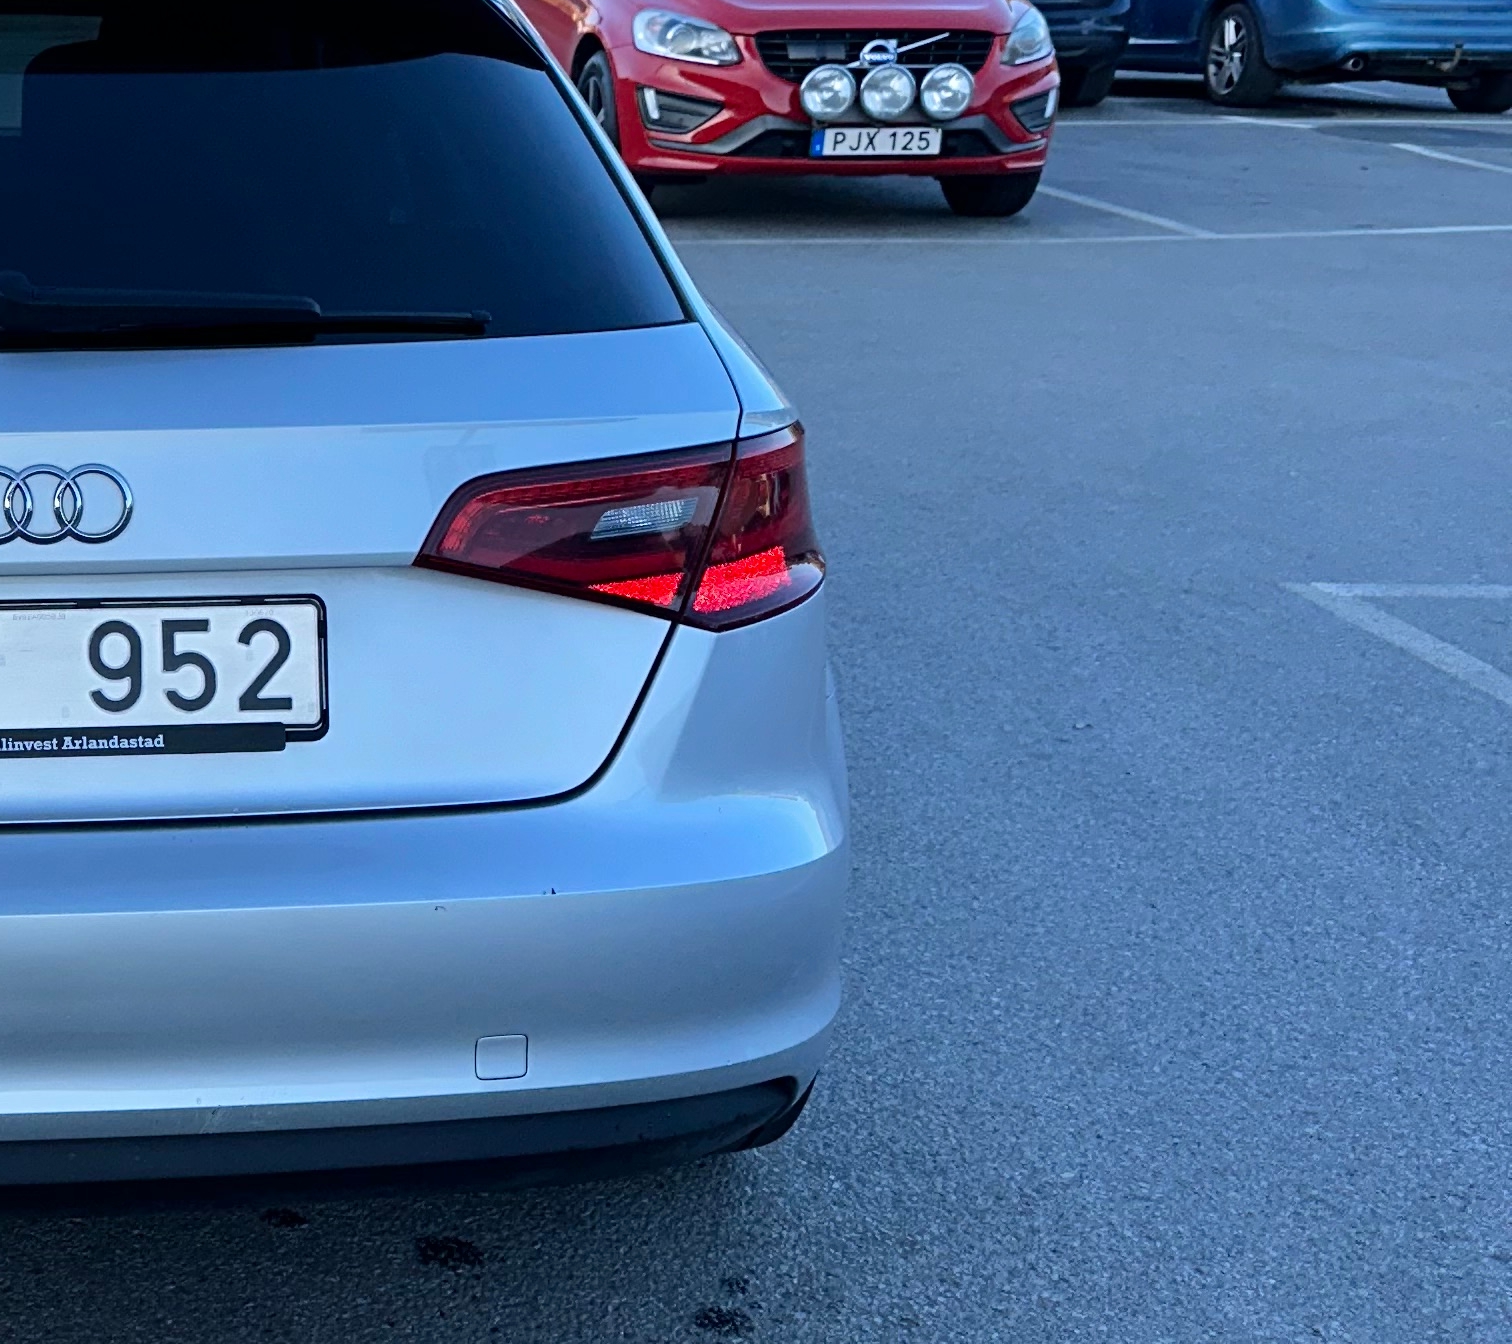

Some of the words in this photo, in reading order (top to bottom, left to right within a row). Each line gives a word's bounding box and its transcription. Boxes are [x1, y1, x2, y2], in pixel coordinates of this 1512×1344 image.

[832, 131, 877, 152] PJX
[889, 130, 931, 152] 125
[88, 619, 293, 713] 952
[61, 733, 165, 750] Arlandastad
